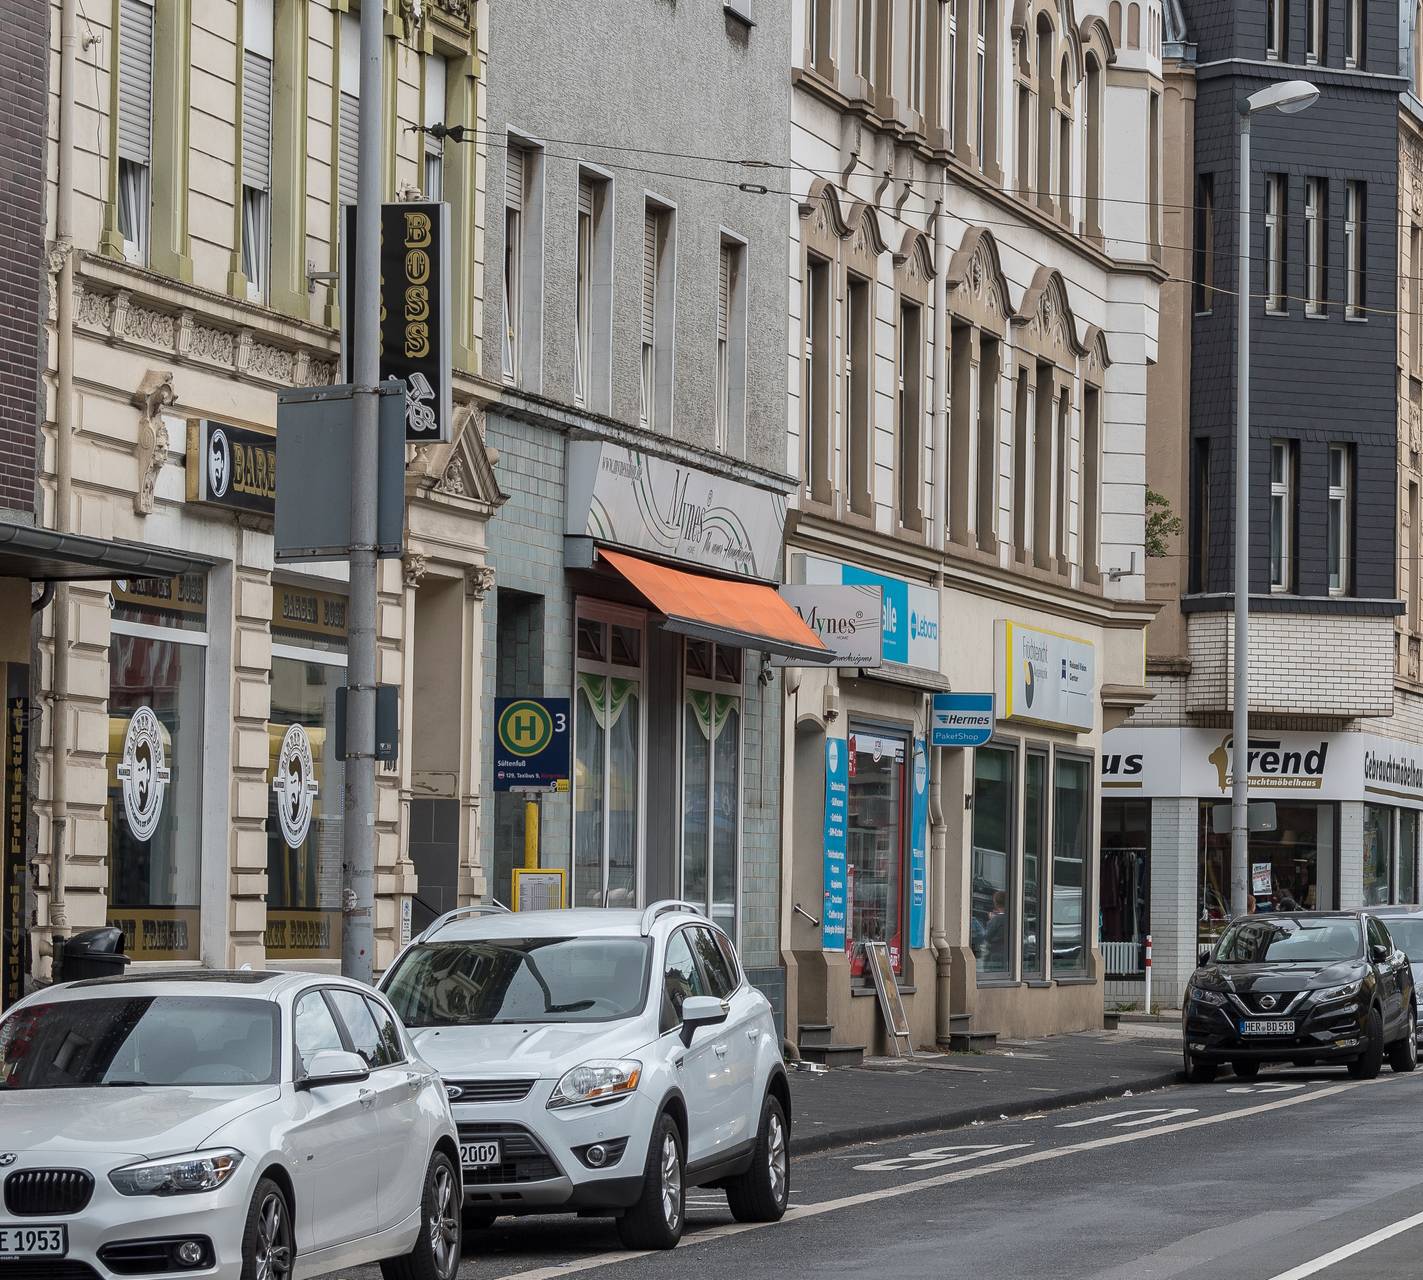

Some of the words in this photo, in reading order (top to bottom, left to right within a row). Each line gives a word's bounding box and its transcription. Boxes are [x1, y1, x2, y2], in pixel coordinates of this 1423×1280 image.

[404, 212, 432, 358] BOSS
[666, 469, 705, 554] Mynes
[917, 614, 937, 640] Lebara
[554, 713, 567, 732] 3
[949, 714, 989, 724] Hermes
[935, 732, 979, 741] PaketShop
[11, 698, 23, 854] Frühstück
[1246, 1022, 1261, 1031] HER
[1266, 1022, 1277, 1031] BD
[1278, 1021, 1294, 1031] 518
[460, 1145, 497, 1163] 2009
[14, 1230, 60, 1251] 1953
